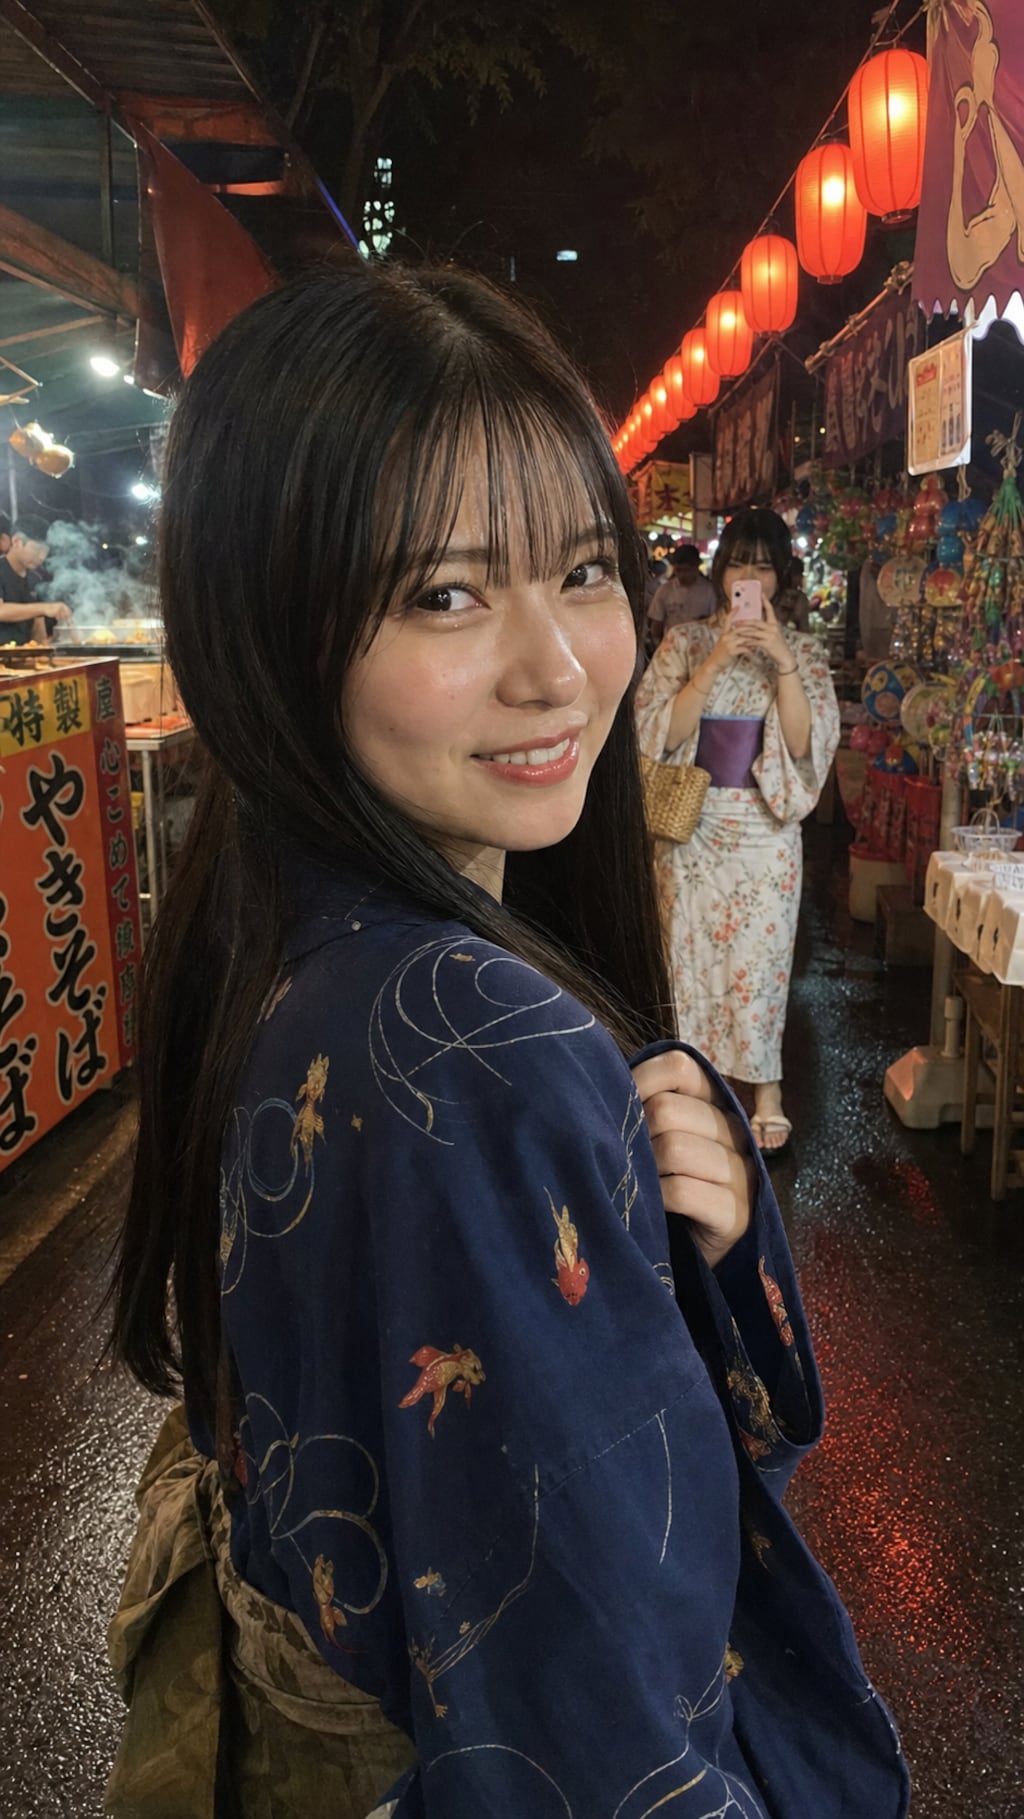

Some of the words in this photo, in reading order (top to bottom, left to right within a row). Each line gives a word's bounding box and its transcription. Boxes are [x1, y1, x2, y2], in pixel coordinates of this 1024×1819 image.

[0, 680, 82, 747] 特製
[22, 752, 107, 1102] やきそば
